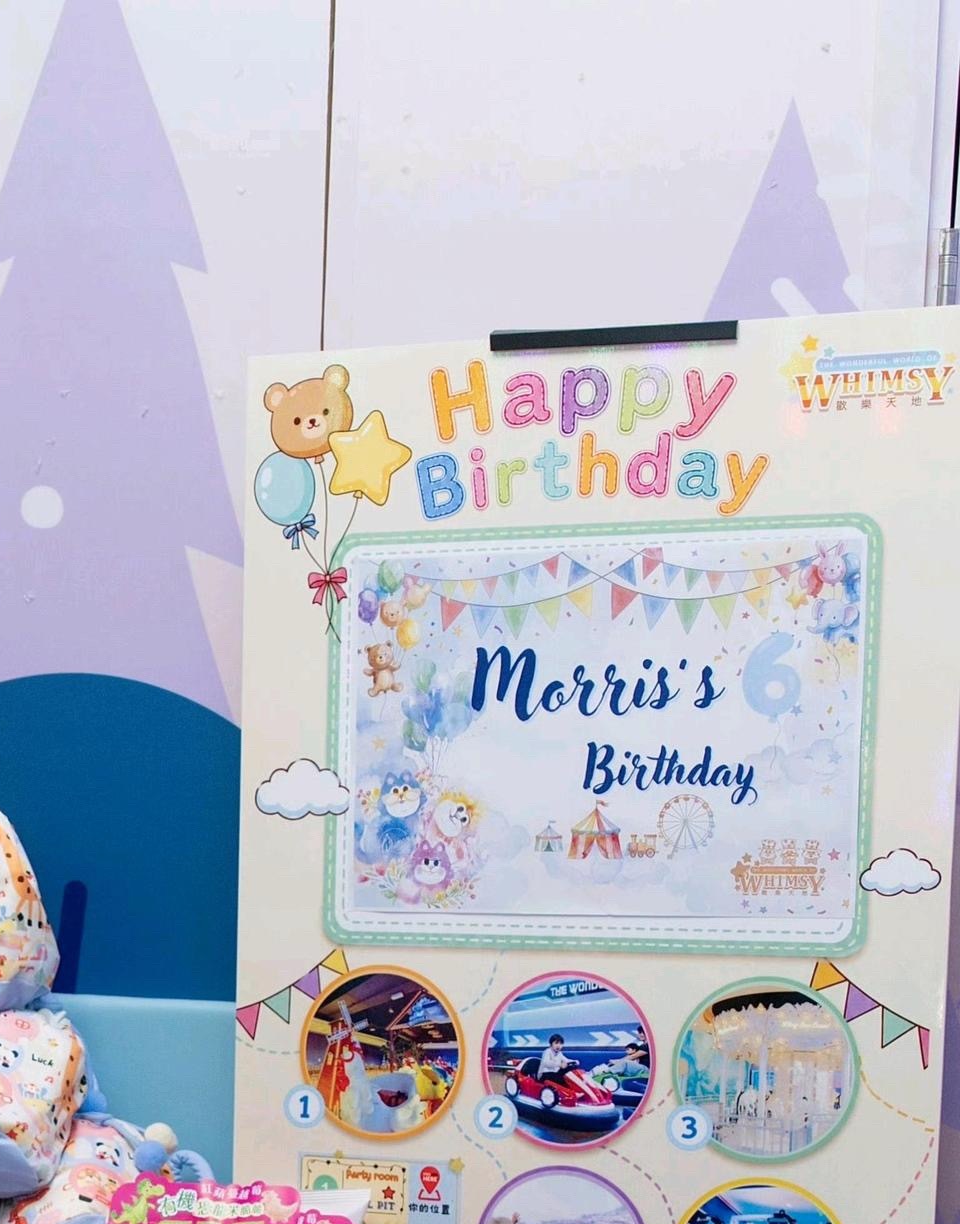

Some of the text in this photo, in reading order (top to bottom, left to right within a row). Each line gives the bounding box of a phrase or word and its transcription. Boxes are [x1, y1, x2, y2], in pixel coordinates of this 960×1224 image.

[428, 358, 737, 443] Happy
[795, 366, 956, 411] WHIMSY
[415, 431, 771, 521] Birthday
[471, 645, 726, 722] Morris's
[742, 632, 803, 717] 6
[583, 741, 759, 806] Birthday
[740, 875, 825, 896] WHIMSY
[31, 1054, 55, 1067] Luck
[296, 1095, 312, 1120] 1
[487, 1105, 505, 1129] 2
[680, 1114, 699, 1140] 3
[346, 1170, 399, 1182] Party room
[377, 1202, 396, 1211] PIT
[409, 1203, 451, 1216] 你的位置
